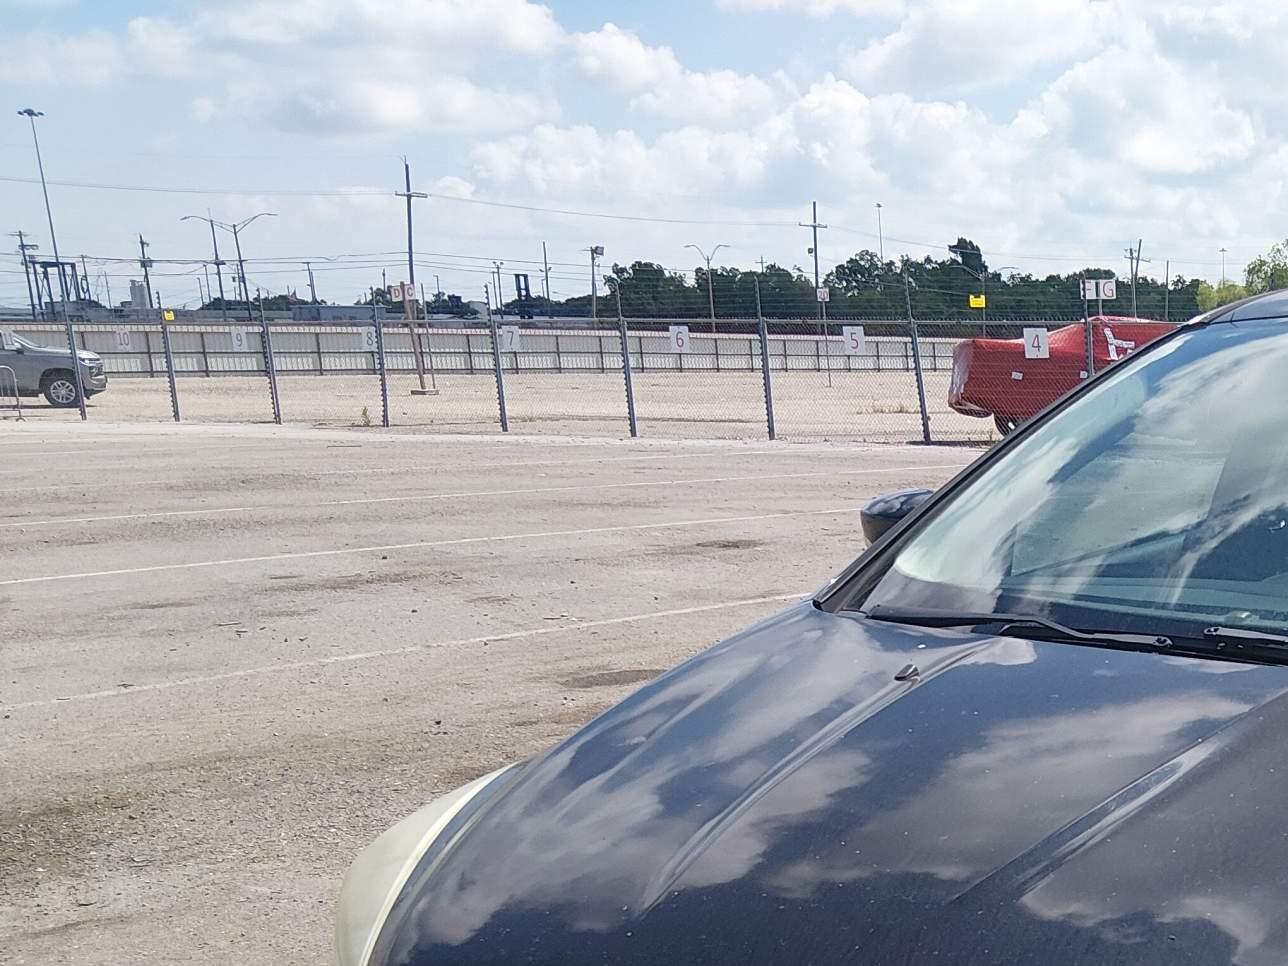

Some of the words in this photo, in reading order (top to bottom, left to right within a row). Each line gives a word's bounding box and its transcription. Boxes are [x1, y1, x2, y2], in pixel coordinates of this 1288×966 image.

[1103, 281, 1114, 298] G
[117, 331, 130, 346] 10
[235, 332, 243, 347] 9
[366, 331, 374, 346] 8
[507, 330, 514, 346] 7
[675, 331, 684, 348] 6
[850, 333, 859, 349] 5
[1031, 334, 1042, 353] 4
